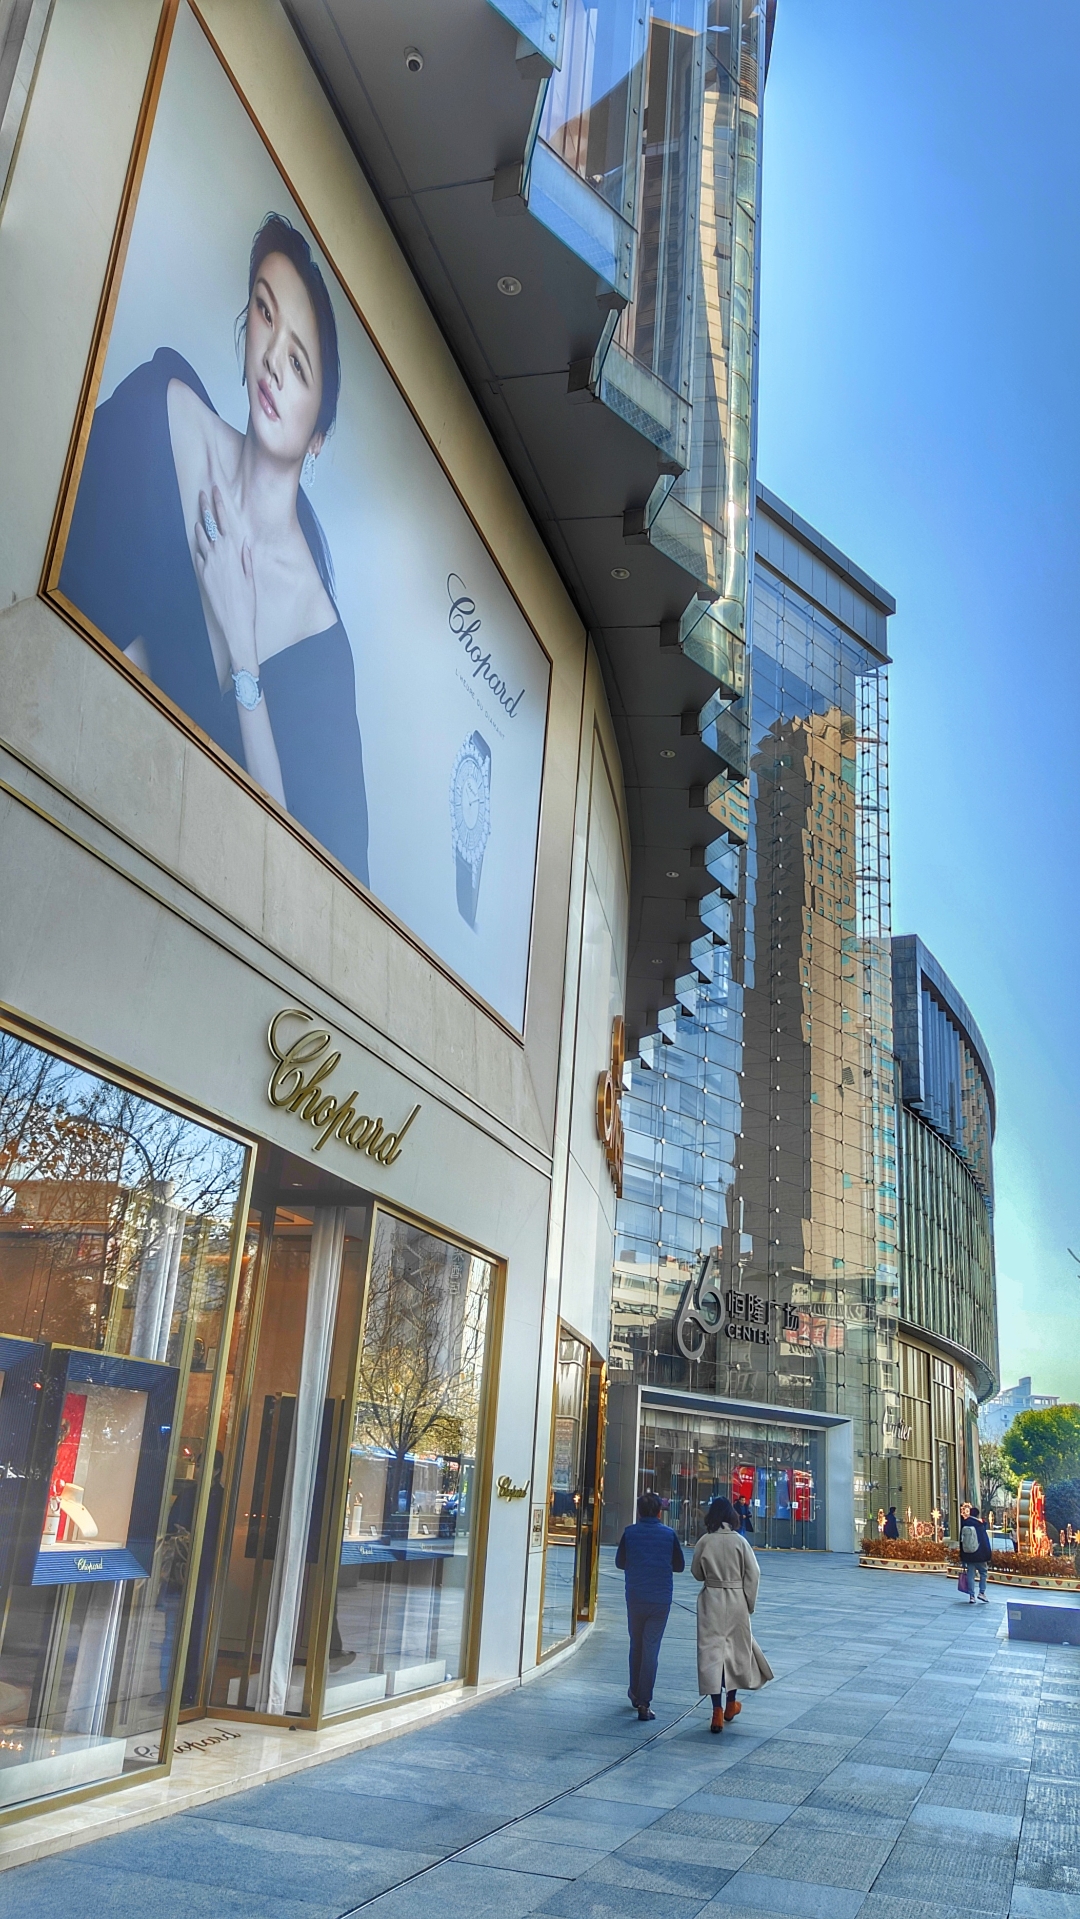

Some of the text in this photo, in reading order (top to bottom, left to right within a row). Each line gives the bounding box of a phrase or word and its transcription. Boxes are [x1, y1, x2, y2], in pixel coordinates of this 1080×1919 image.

[446, 572, 526, 719] Chopard
[476, 699, 485, 712] DU
[267, 1008, 422, 1168] Chopard
[726, 1289, 800, 1332] 恒隆广场
[725, 1322, 771, 1346] CENTER
[496, 1475, 530, 1504] Chopard
[73, 1556, 104, 1574] Chopard
